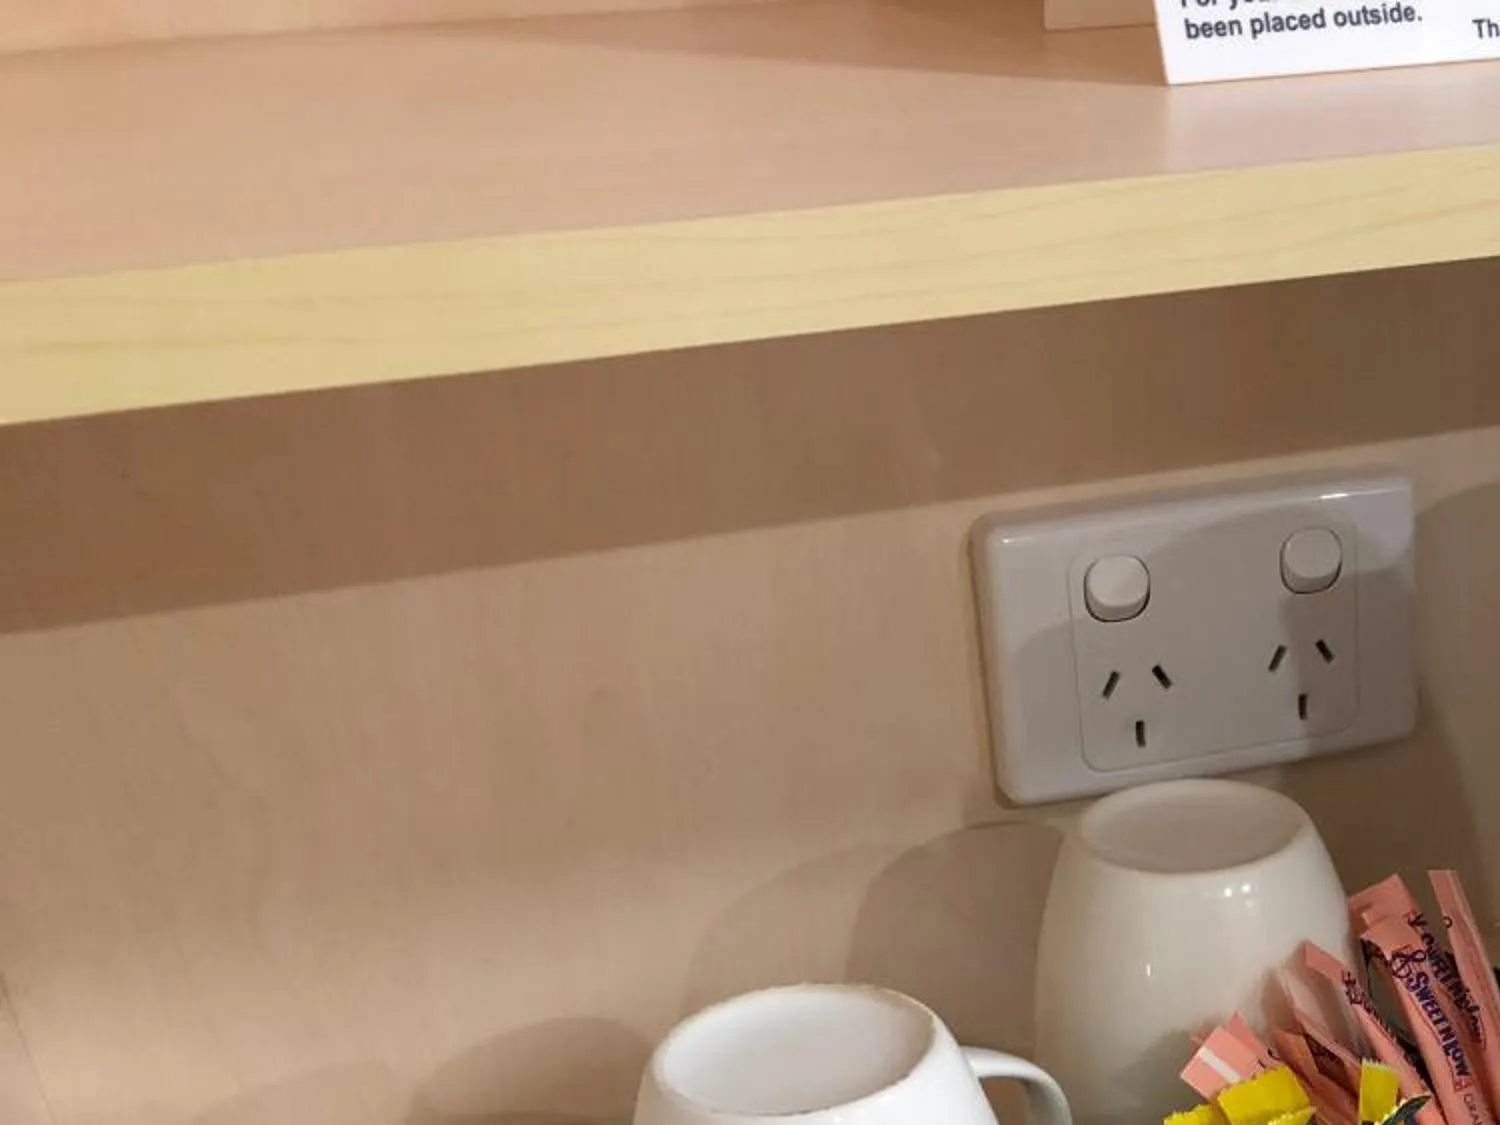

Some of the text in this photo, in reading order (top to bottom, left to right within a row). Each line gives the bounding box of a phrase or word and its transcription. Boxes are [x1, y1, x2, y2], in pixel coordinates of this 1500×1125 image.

[1184, 2, 1422, 39] been placed outside.
